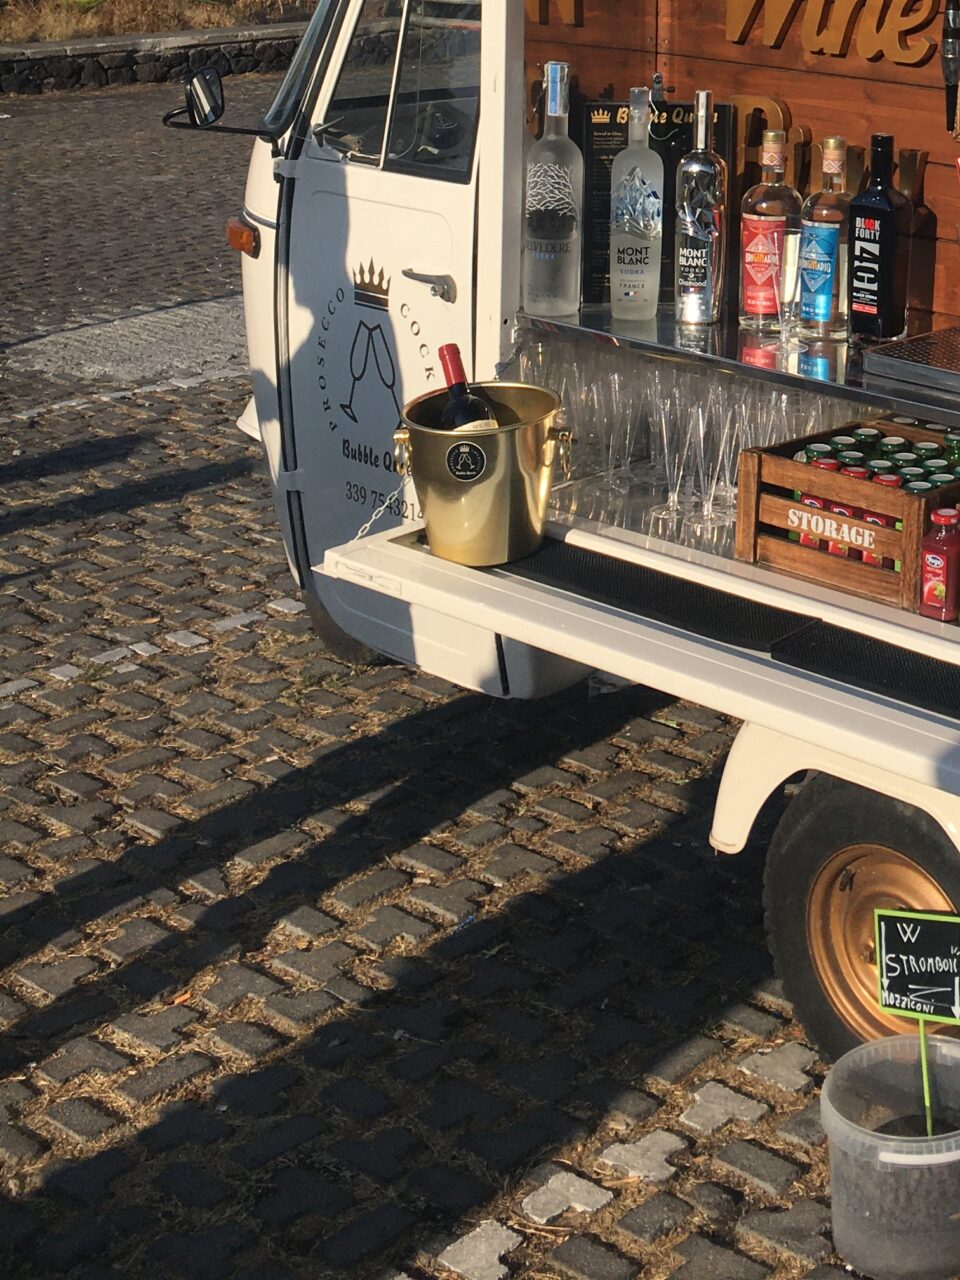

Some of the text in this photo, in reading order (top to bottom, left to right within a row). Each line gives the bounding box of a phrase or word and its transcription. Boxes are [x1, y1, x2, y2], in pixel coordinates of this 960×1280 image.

[855, 227, 880, 241] FORTY
[617, 246, 650, 257] MONT
[679, 247, 708, 258] MONT
[617, 256, 650, 266] BLANC
[679, 257, 708, 267] BLANC
[678, 278, 707, 287] Diamond
[318, 288, 436, 432] PROSECCO COCK
[342, 437, 380, 468] Bubble
[345, 481, 367, 506] 339
[787, 508, 876, 550] STORAGE
[896, 922, 921, 944] W
